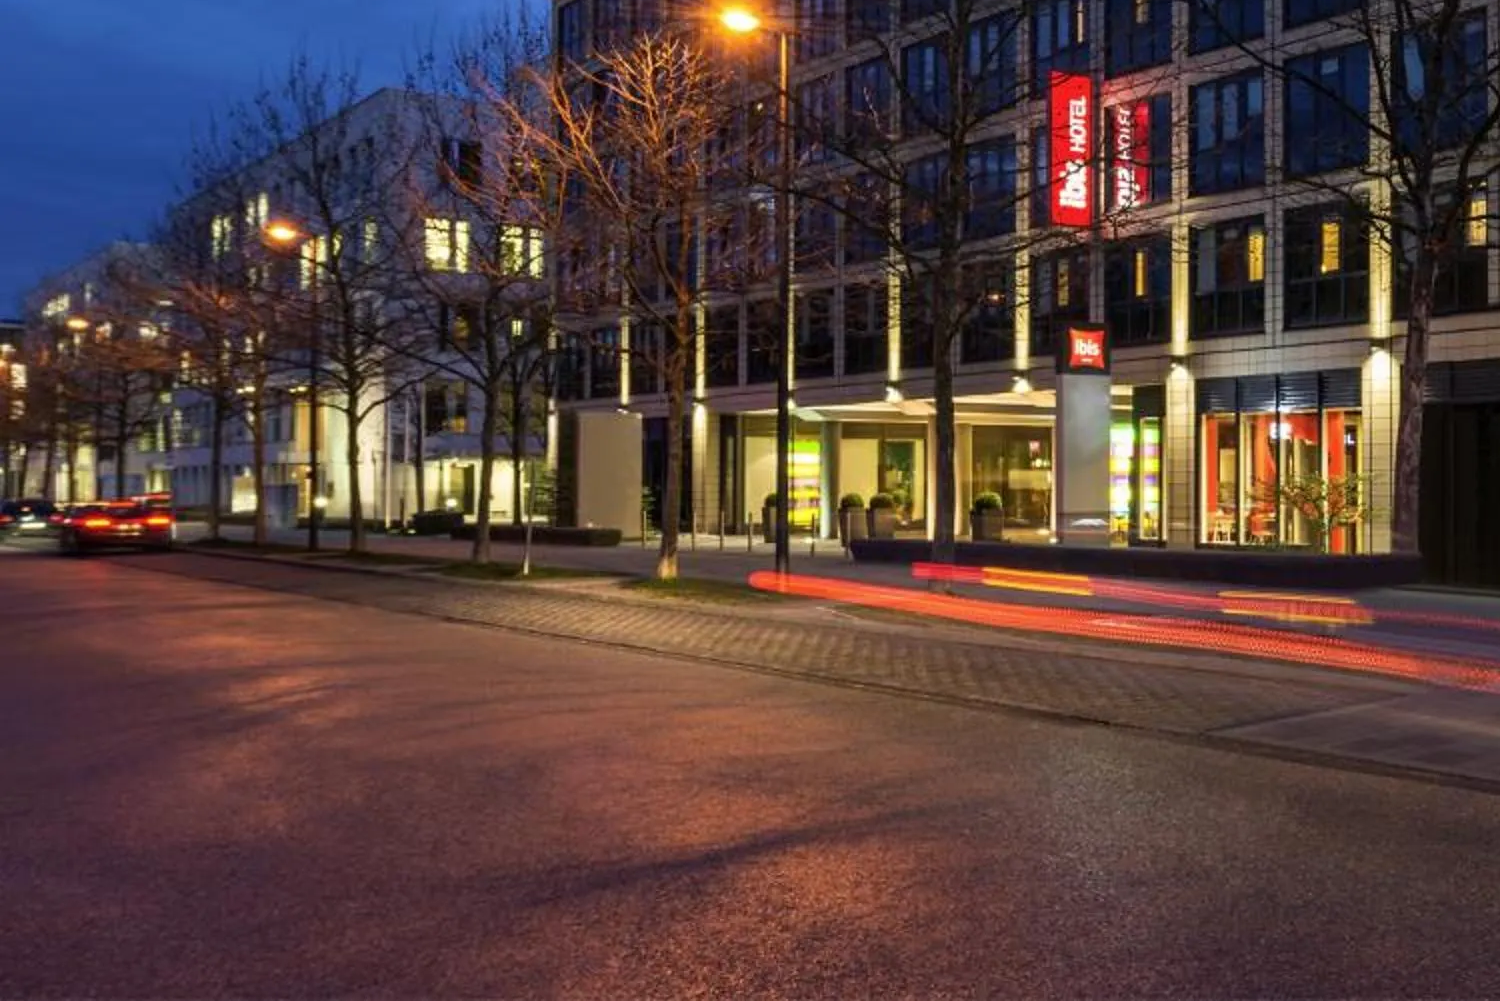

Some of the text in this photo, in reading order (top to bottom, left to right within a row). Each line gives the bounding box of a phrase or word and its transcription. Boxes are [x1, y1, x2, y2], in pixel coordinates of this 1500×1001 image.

[1059, 96, 1087, 208] ibis HOTEL
[1073, 338, 1100, 356] ibis
